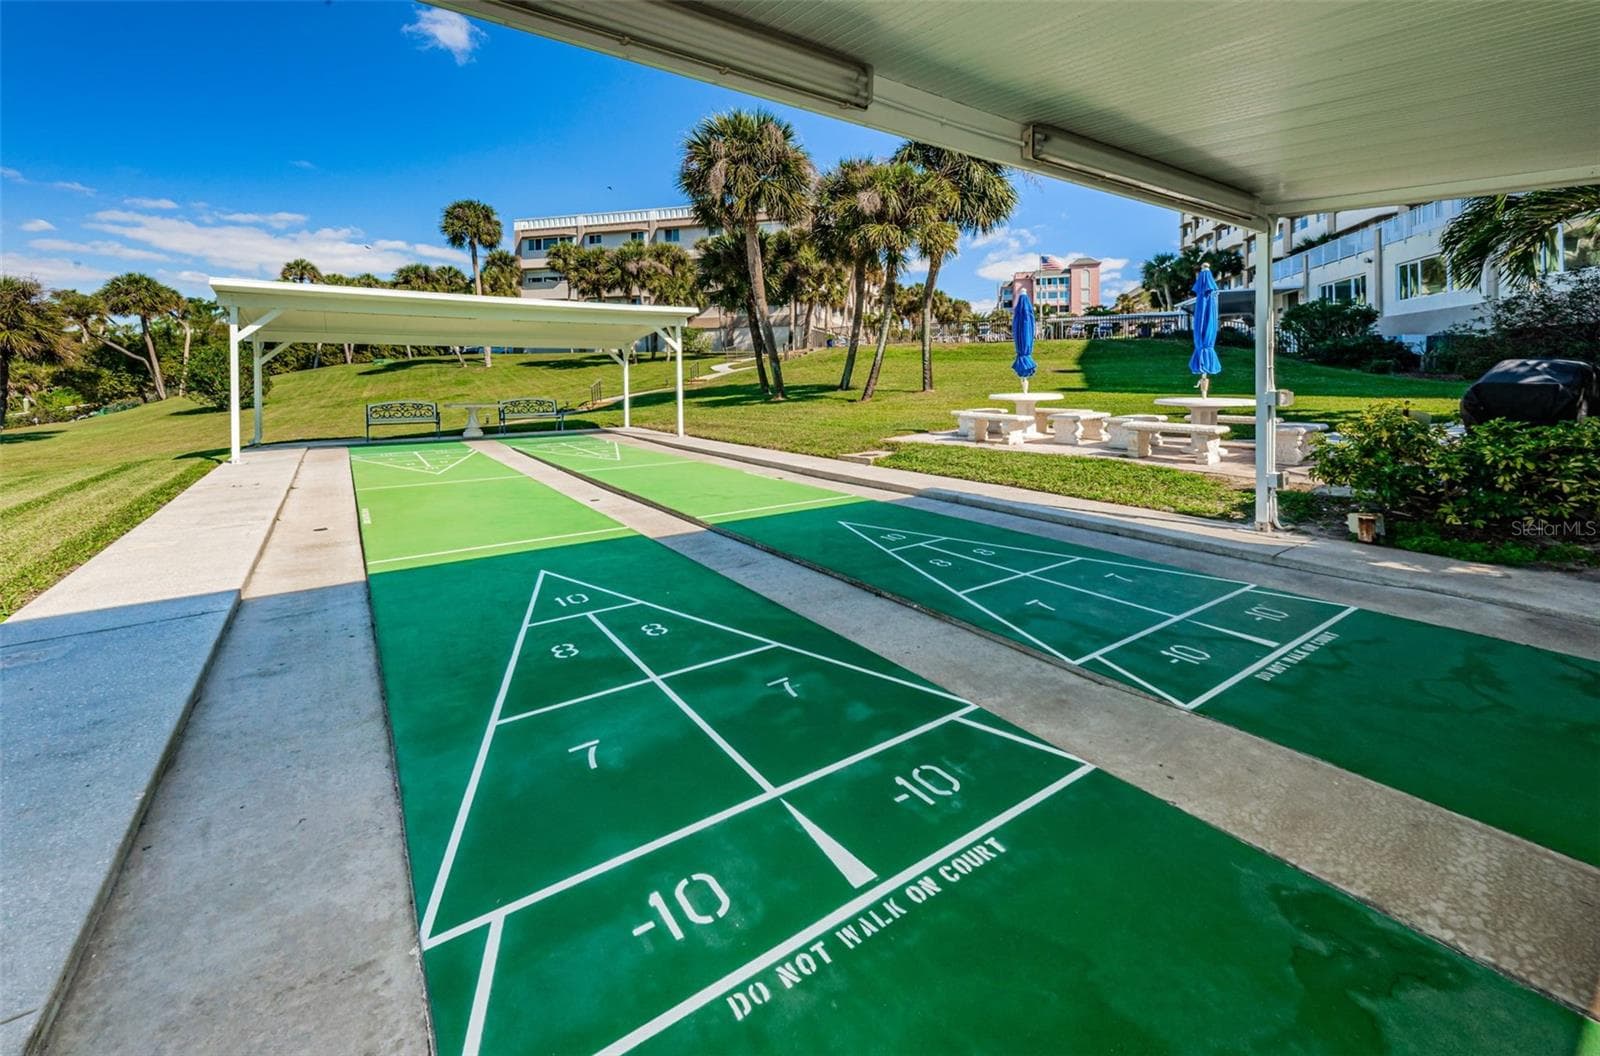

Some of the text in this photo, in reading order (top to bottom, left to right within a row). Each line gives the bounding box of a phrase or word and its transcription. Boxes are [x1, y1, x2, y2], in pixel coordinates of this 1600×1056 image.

[880, 533, 906, 541] 10
[973, 548, 995, 556] 8
[929, 559, 952, 567] 8
[1104, 573, 1133, 582] 7
[554, 592, 589, 607] 10
[1025, 599, 1056, 611] 7
[1244, 606, 1289, 622] -10
[641, 623, 668, 636] 8
[551, 643, 579, 659] 8
[1160, 644, 1211, 665] -10
[766, 677, 798, 698] 7
[568, 739, 600, 769] 7
[894, 764, 961, 806] -10
[632, 873, 730, 941] -10
[726, 837, 1006, 1022] DO NOT WALK ON COURT
